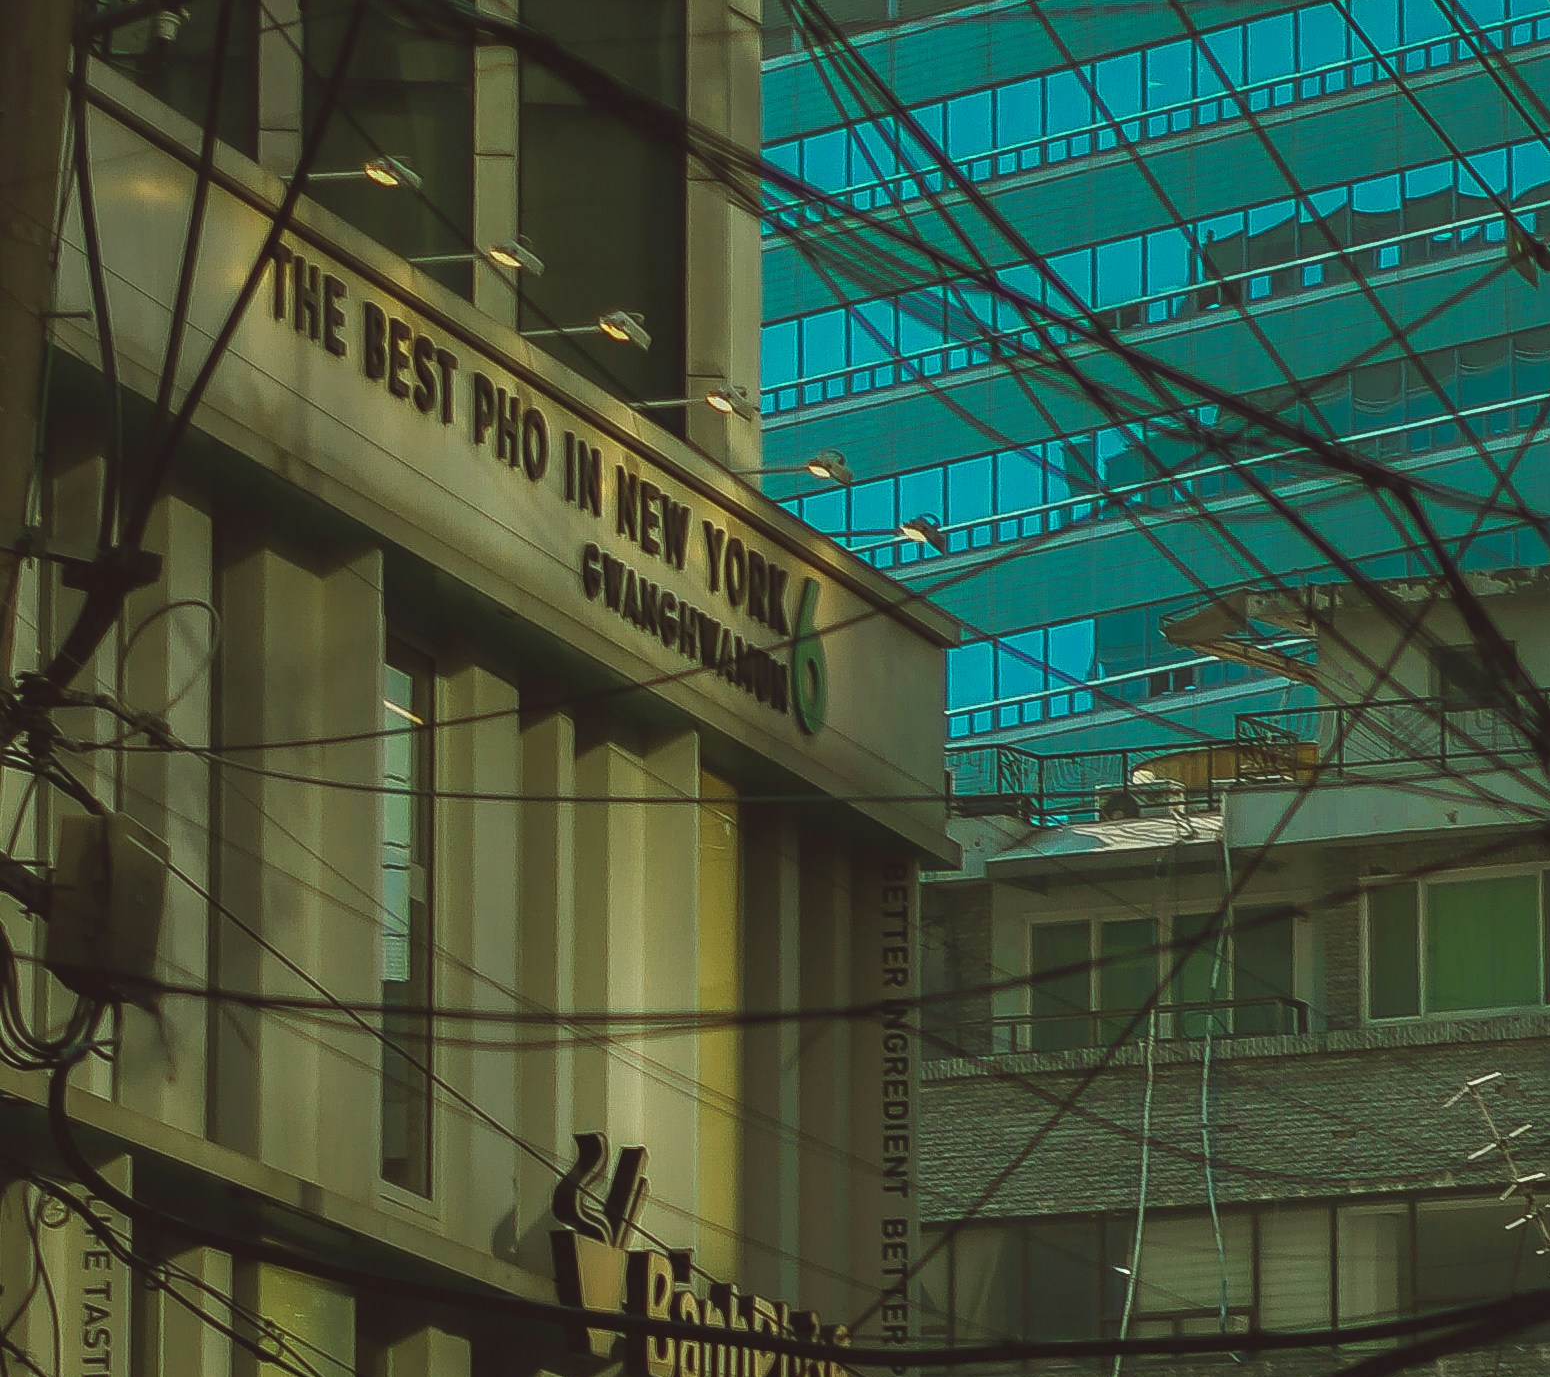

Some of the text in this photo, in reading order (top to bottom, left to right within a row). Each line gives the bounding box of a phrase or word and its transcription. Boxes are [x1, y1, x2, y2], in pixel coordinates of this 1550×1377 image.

[272, 240, 790, 637] THE BEST PHO IN NEW YORK
[881, 863, 909, 988] BETTER
[881, 998, 909, 1198] INGREDIENT
[881, 1218, 909, 1344] BETTER
